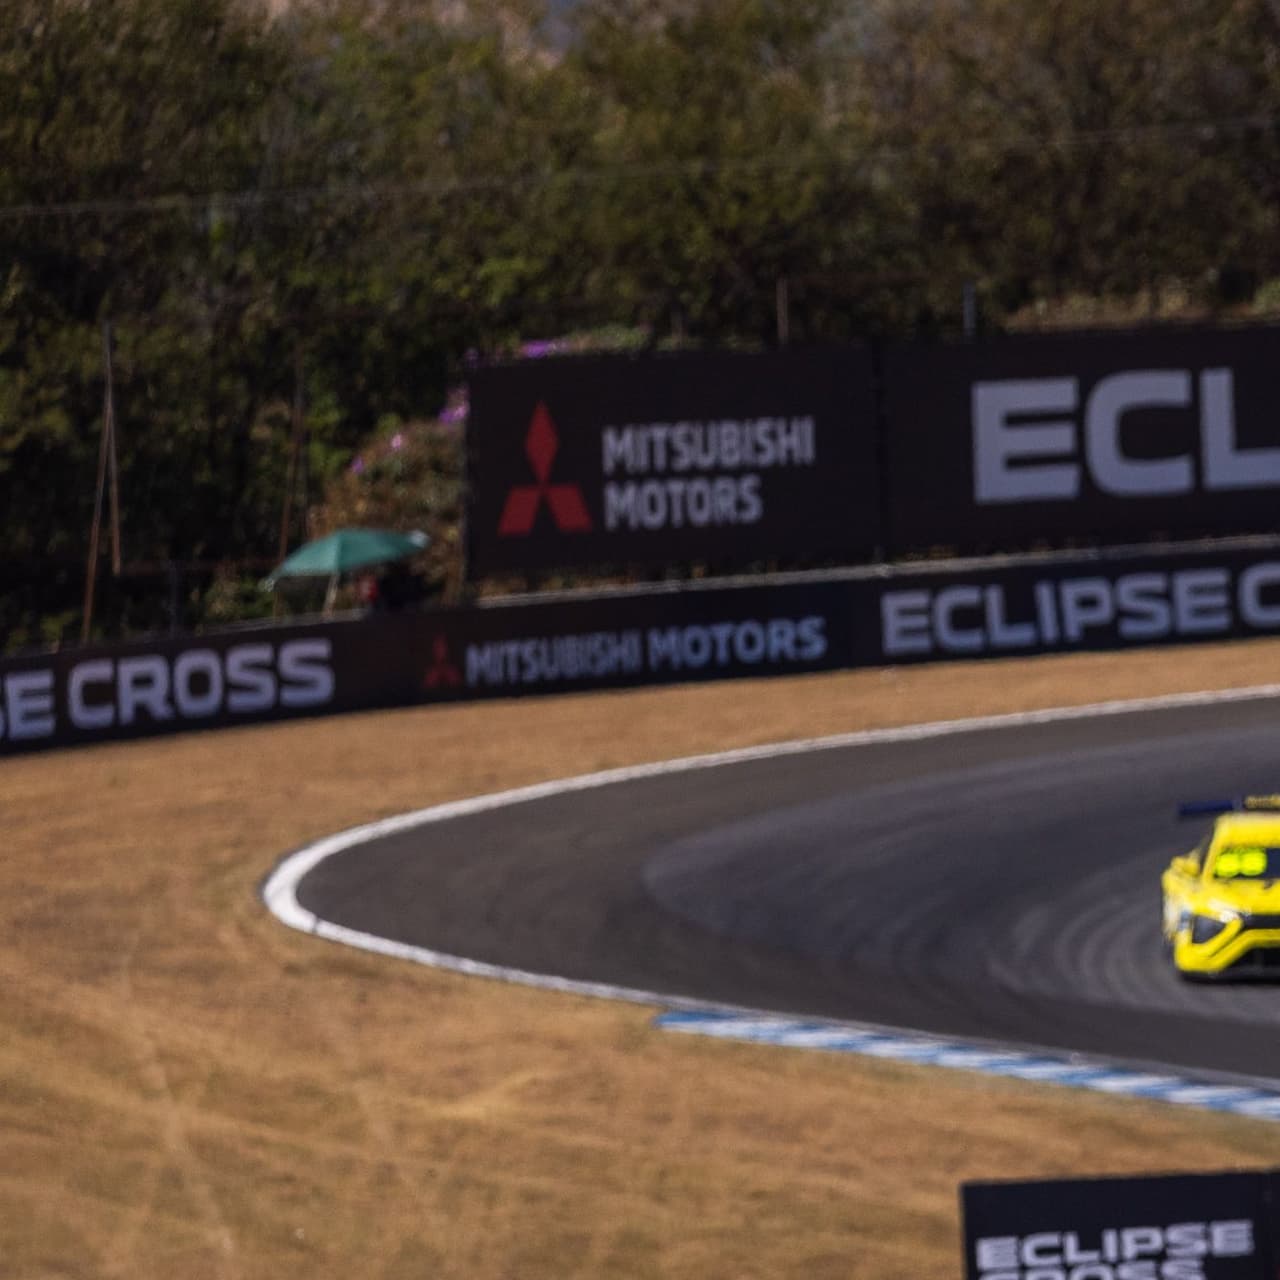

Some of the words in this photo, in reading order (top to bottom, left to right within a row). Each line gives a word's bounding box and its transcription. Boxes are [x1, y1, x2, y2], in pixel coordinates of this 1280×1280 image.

[602, 416, 815, 473] MITSUBISHI
[604, 474, 764, 530] MOTORS
[881, 568, 1231, 656] ECLIPSE
[466, 634, 642, 688] MITSUBISHI
[647, 615, 828, 669] MOTORS
[0, 667, 55, 740] E
[67, 637, 335, 730] CROSS
[975, 1219, 1255, 1271] ECLIPSE
